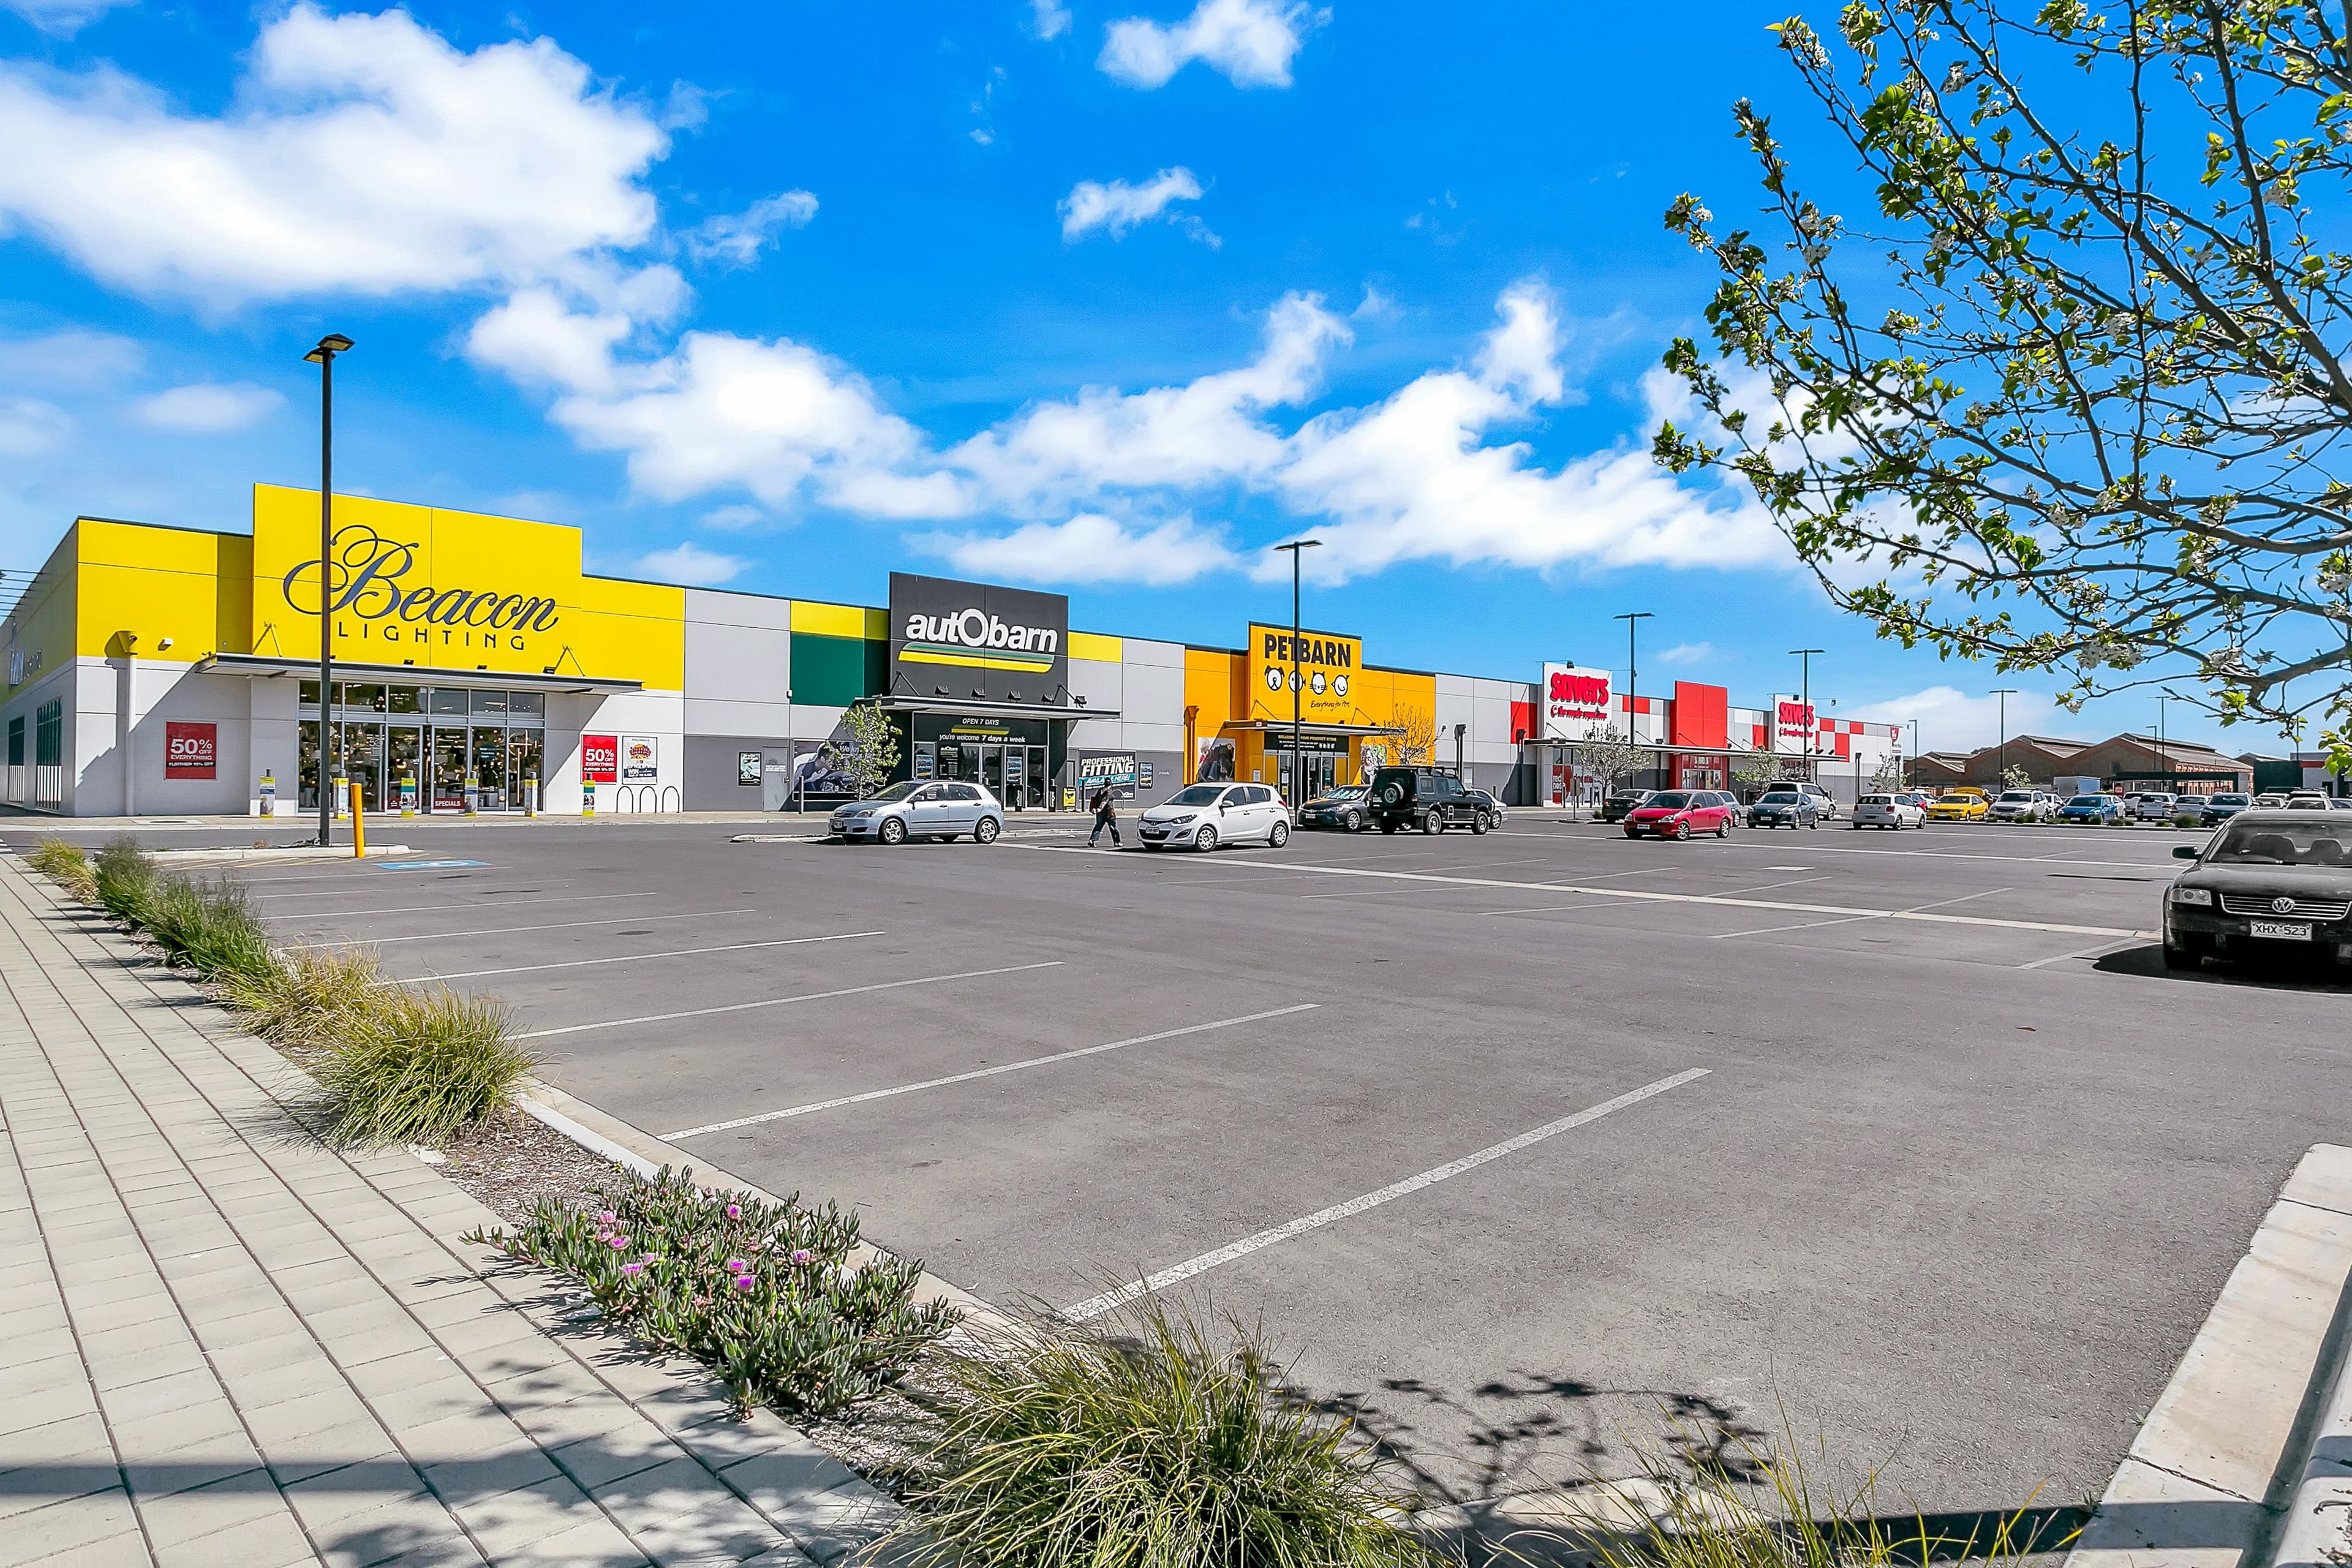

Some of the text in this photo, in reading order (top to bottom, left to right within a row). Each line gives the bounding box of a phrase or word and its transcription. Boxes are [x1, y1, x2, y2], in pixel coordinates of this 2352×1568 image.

[283, 525, 559, 631] Beacon
[338, 621, 524, 650] LIGHTING
[1265, 633, 1351, 668] PETBARN
[1311, 700, 1335, 711] Everything
[170, 739, 212, 754] 50%
[586, 748, 614, 762] 50%
[1081, 755, 1134, 766] PROFESSIONAL
[1082, 761, 1134, 777] FITTING
[2255, 924, 2306, 936] XHX 523
